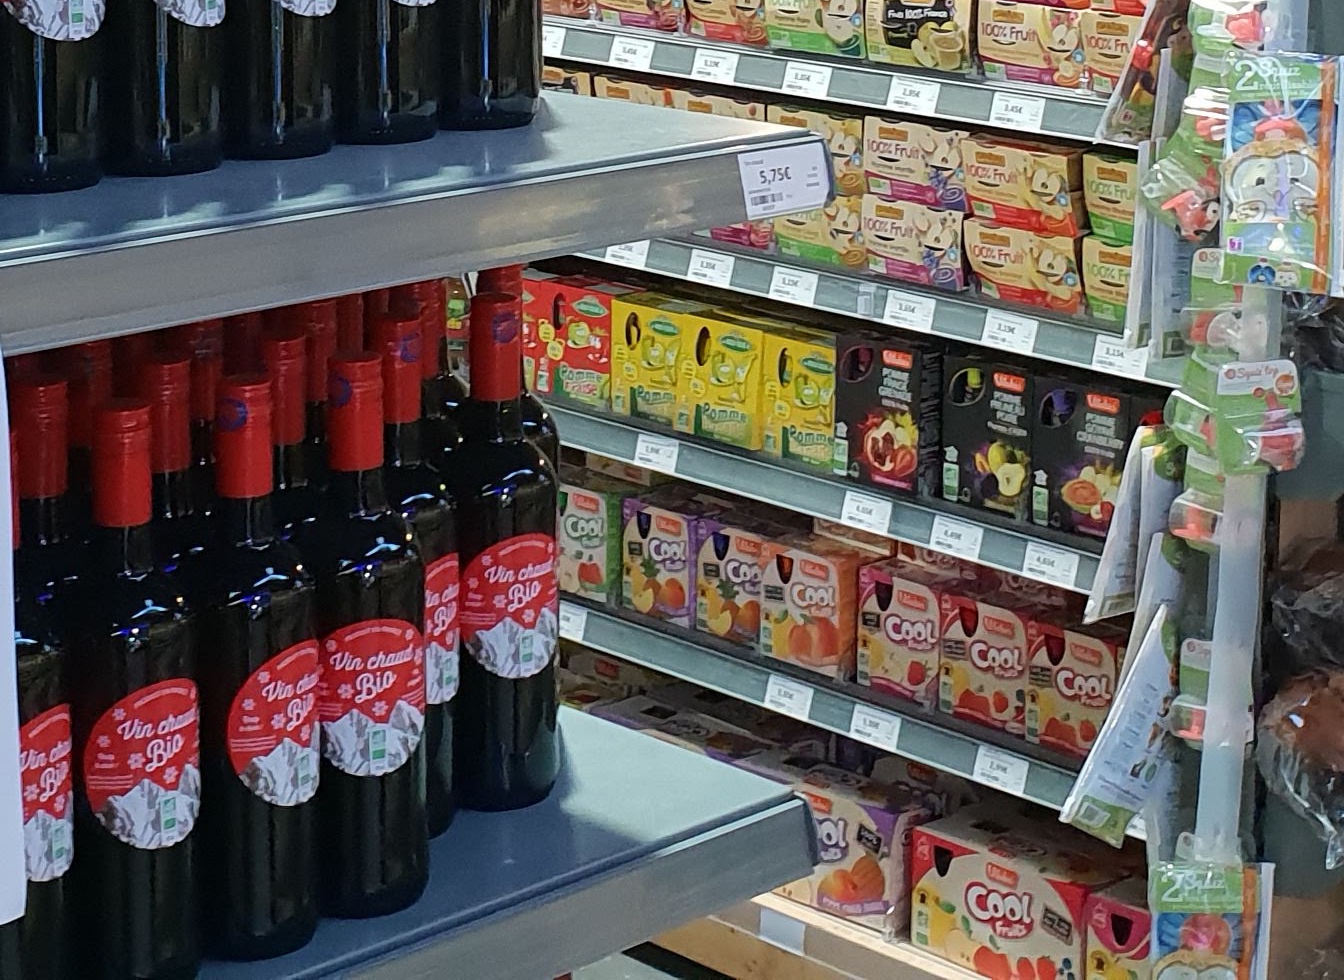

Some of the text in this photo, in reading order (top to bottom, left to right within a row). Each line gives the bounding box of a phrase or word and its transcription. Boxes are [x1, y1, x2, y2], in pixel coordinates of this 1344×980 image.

[905, 8, 923, 18] 100%
[981, 22, 1038, 42] 100% Fruit
[1085, 35, 1110, 49] 100%
[867, 139, 920, 160] 100% Fruit
[760, 167, 791, 185] 5,75€
[966, 164, 1019, 185] 100% Fruit
[1087, 180, 1113, 195] 100%
[864, 217, 914, 238] 100% Fruit
[971, 244, 1023, 265] 100% Fruit
[1087, 261, 1111, 278] 100%
[560, 365, 602, 382] Pomme
[702, 403, 746, 423] Pomme
[790, 425, 834, 444] Pomme
[484, 564, 516, 585] Vin
[506, 582, 543, 613] Bio
[330, 643, 415, 672] Vin chaud
[262, 680, 294, 703] Vin
[355, 671, 397, 704] Bio
[286, 695, 318, 731] Bio
[117, 718, 155, 741] Vin
[145, 733, 185, 774] Bio
[40, 763, 69, 803] Bio
